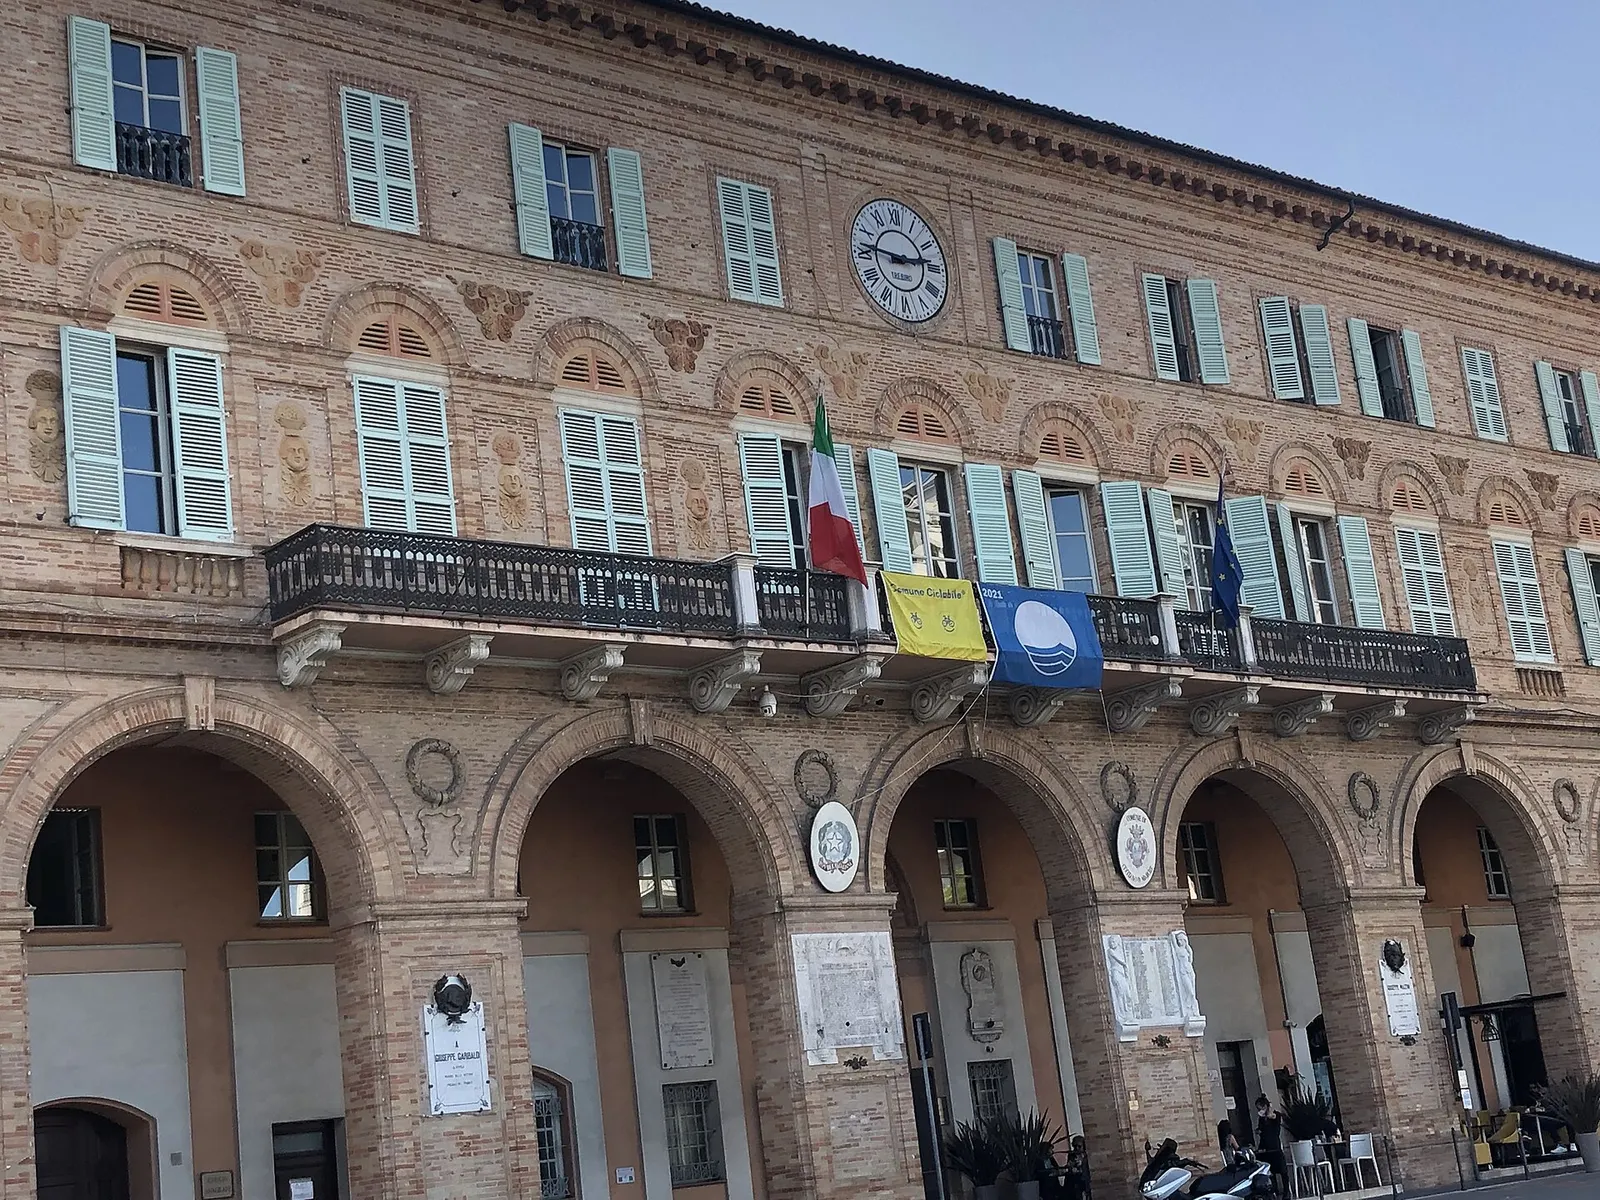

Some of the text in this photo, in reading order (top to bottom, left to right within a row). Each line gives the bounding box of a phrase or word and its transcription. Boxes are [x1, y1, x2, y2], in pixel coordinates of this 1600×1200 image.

[870, 209, 885, 229] XI
[887, 207, 901, 226] XII
[859, 223, 875, 241] X
[856, 246, 873, 261] IX
[920, 240, 933, 251] II
[863, 267, 880, 288] VIII
[927, 263, 941, 274] III
[880, 285, 893, 306] VII
[925, 280, 940, 299] IIII
[901, 295, 912, 315] VI
[917, 294, 929, 312] V
[982, 587, 1004, 599] 2021
